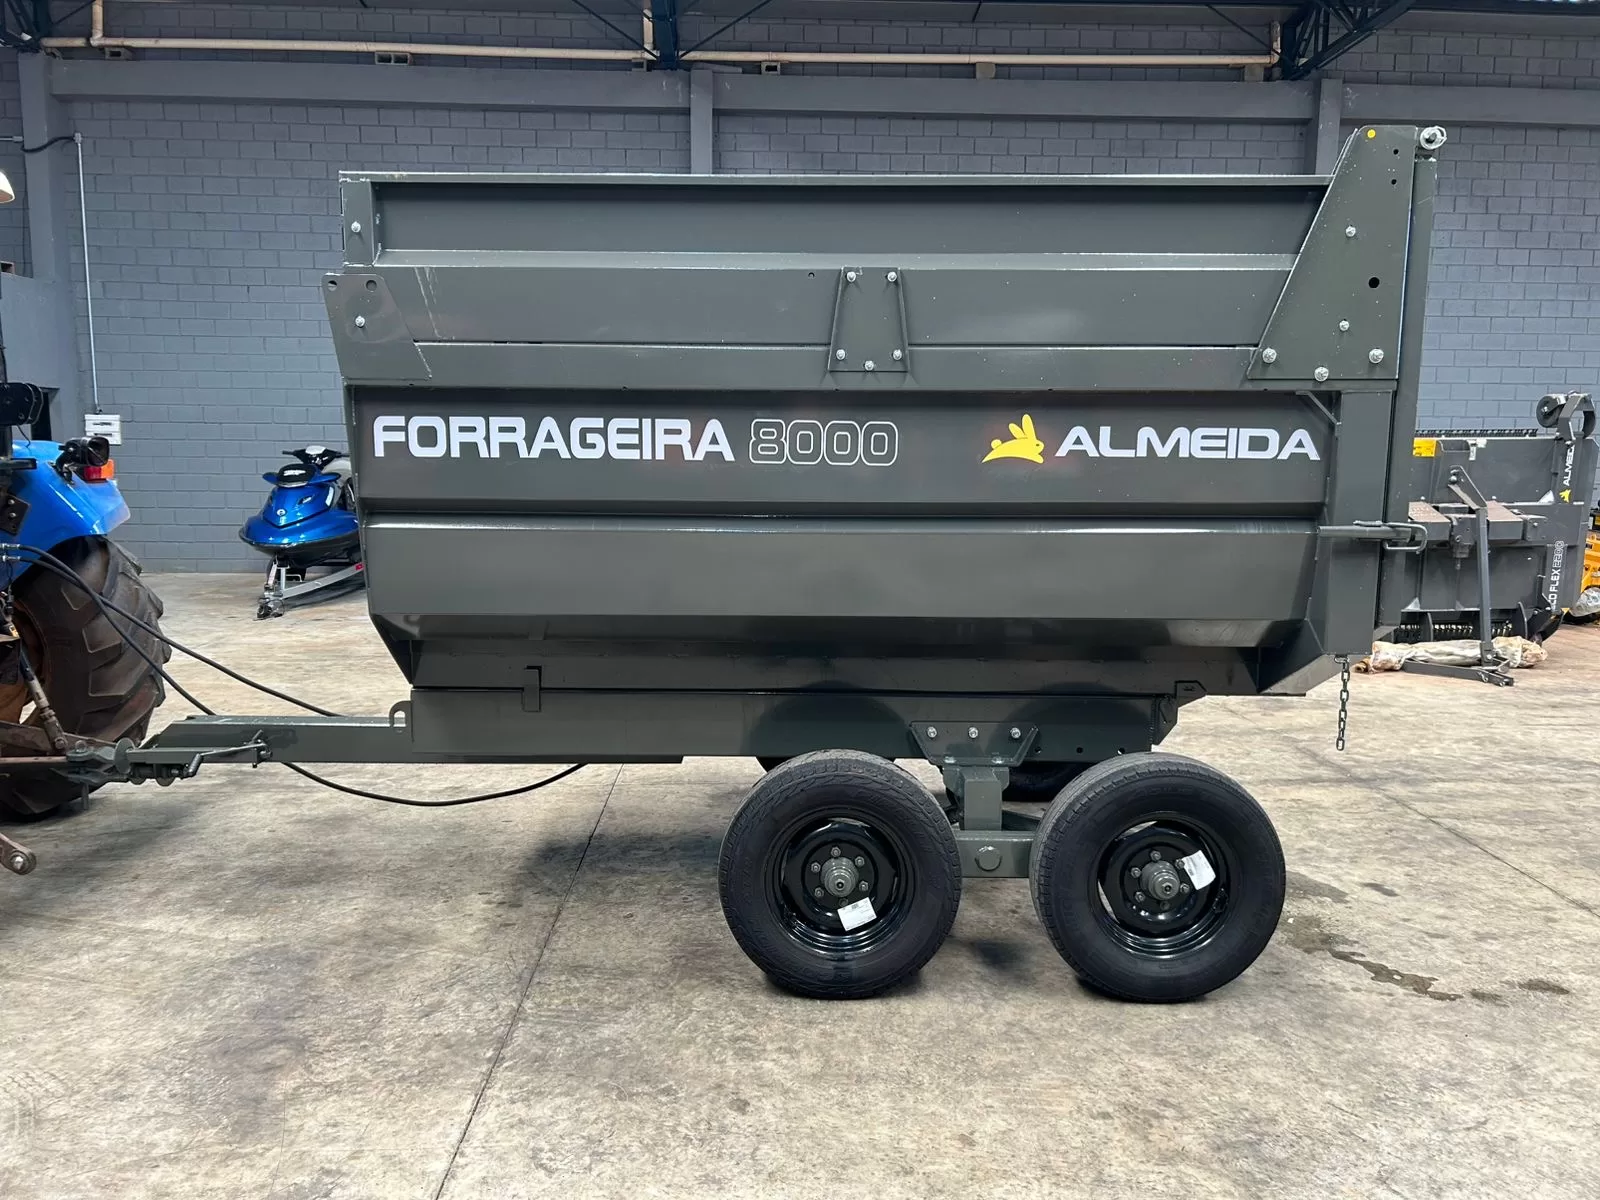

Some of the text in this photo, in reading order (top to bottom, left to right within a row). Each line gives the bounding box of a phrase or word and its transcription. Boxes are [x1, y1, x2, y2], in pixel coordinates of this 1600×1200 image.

[373, 416, 899, 467] FORRAGEIRA 8000
[1054, 425, 1321, 461] ALMEIDA
[1563, 443, 1575, 487] ALMEID
[1549, 569, 1561, 592] FLEX
